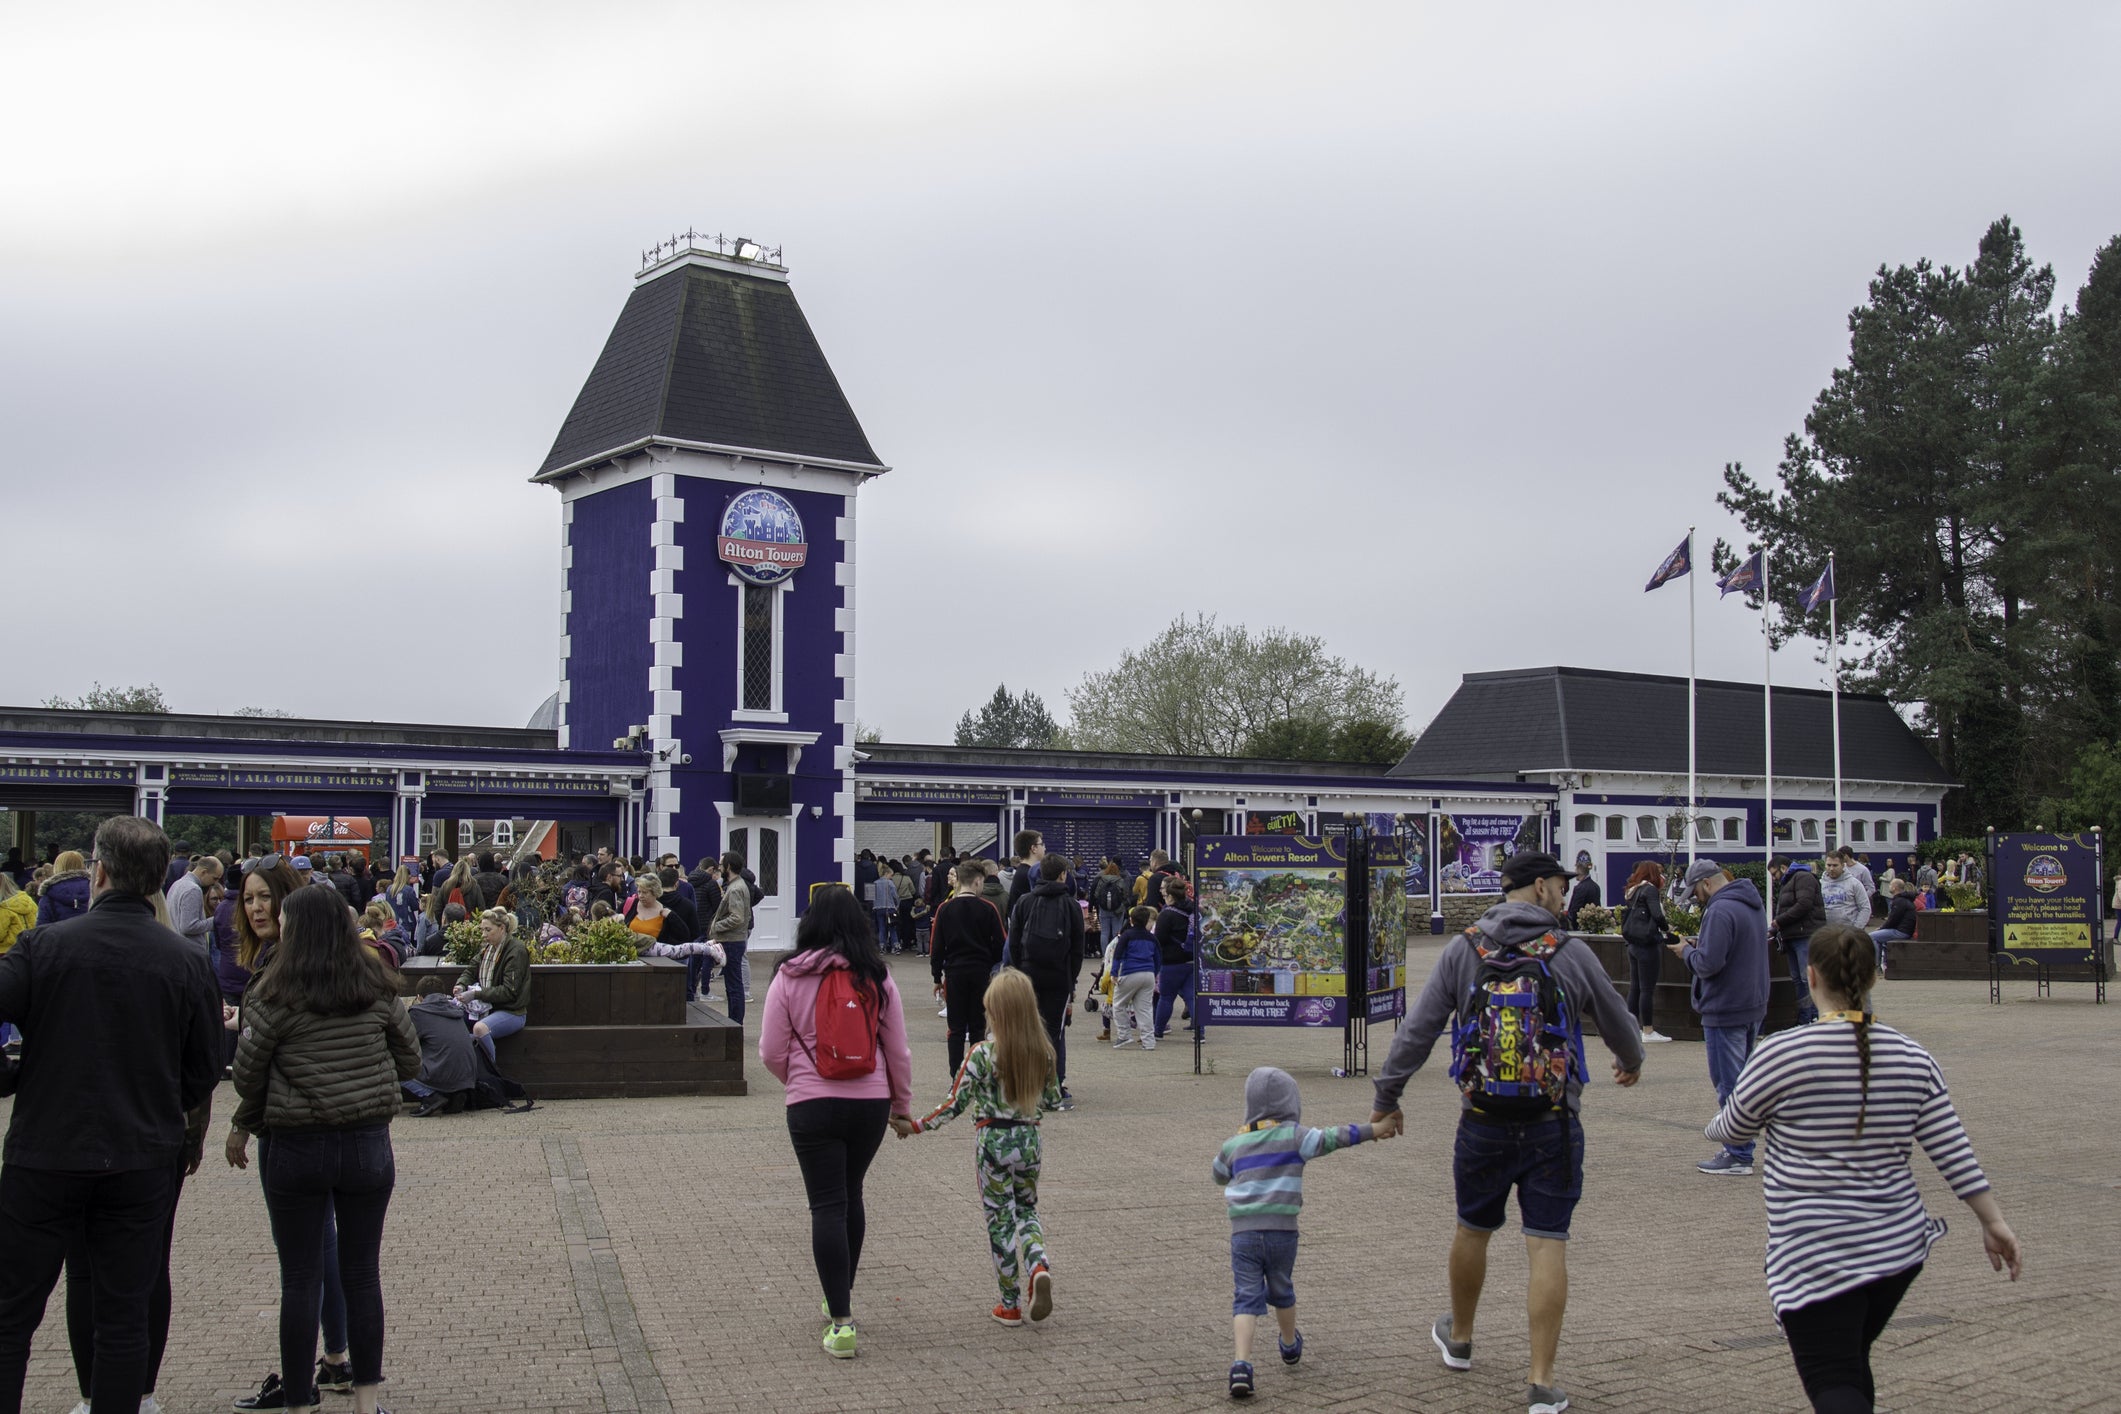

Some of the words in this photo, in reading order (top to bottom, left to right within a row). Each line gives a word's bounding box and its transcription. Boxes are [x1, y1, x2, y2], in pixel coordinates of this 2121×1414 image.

[724, 542, 763, 560] Alton
[766, 547, 804, 562] Towers
[56, 769, 122, 780] TICKETS
[245, 774, 271, 783] ALL
[276, 775, 322, 784] OTHER
[327, 776, 384, 786] TICKETS
[512, 781, 550, 789] OTHER
[554, 782, 600, 790] TICKETS
[872, 790, 888, 798] ALL
[892, 790, 922, 798] OTHER
[924, 791, 961, 800] TICKETS
[1267, 812, 1296, 831] GUILTY!
[1251, 845, 1282, 853] Welcome
[2021, 844, 2057, 852] Welcome
[1224, 852, 1249, 862] Alton
[1252, 853, 1286, 862] Towers
[1288, 853, 1318, 862] Resort
[2012, 904, 2038, 912] already,
[2040, 904, 2062, 912] please
[2008, 912, 2032, 920] straight
[1209, 998, 1220, 1007] Pay
[1236, 998, 1247, 1008] day
[1248, 999, 1259, 1007] and
[1276, 999, 1290, 1007] back
[1212, 1007, 1222, 1016] all
[1500, 983, 1516, 1082] EASTPK
